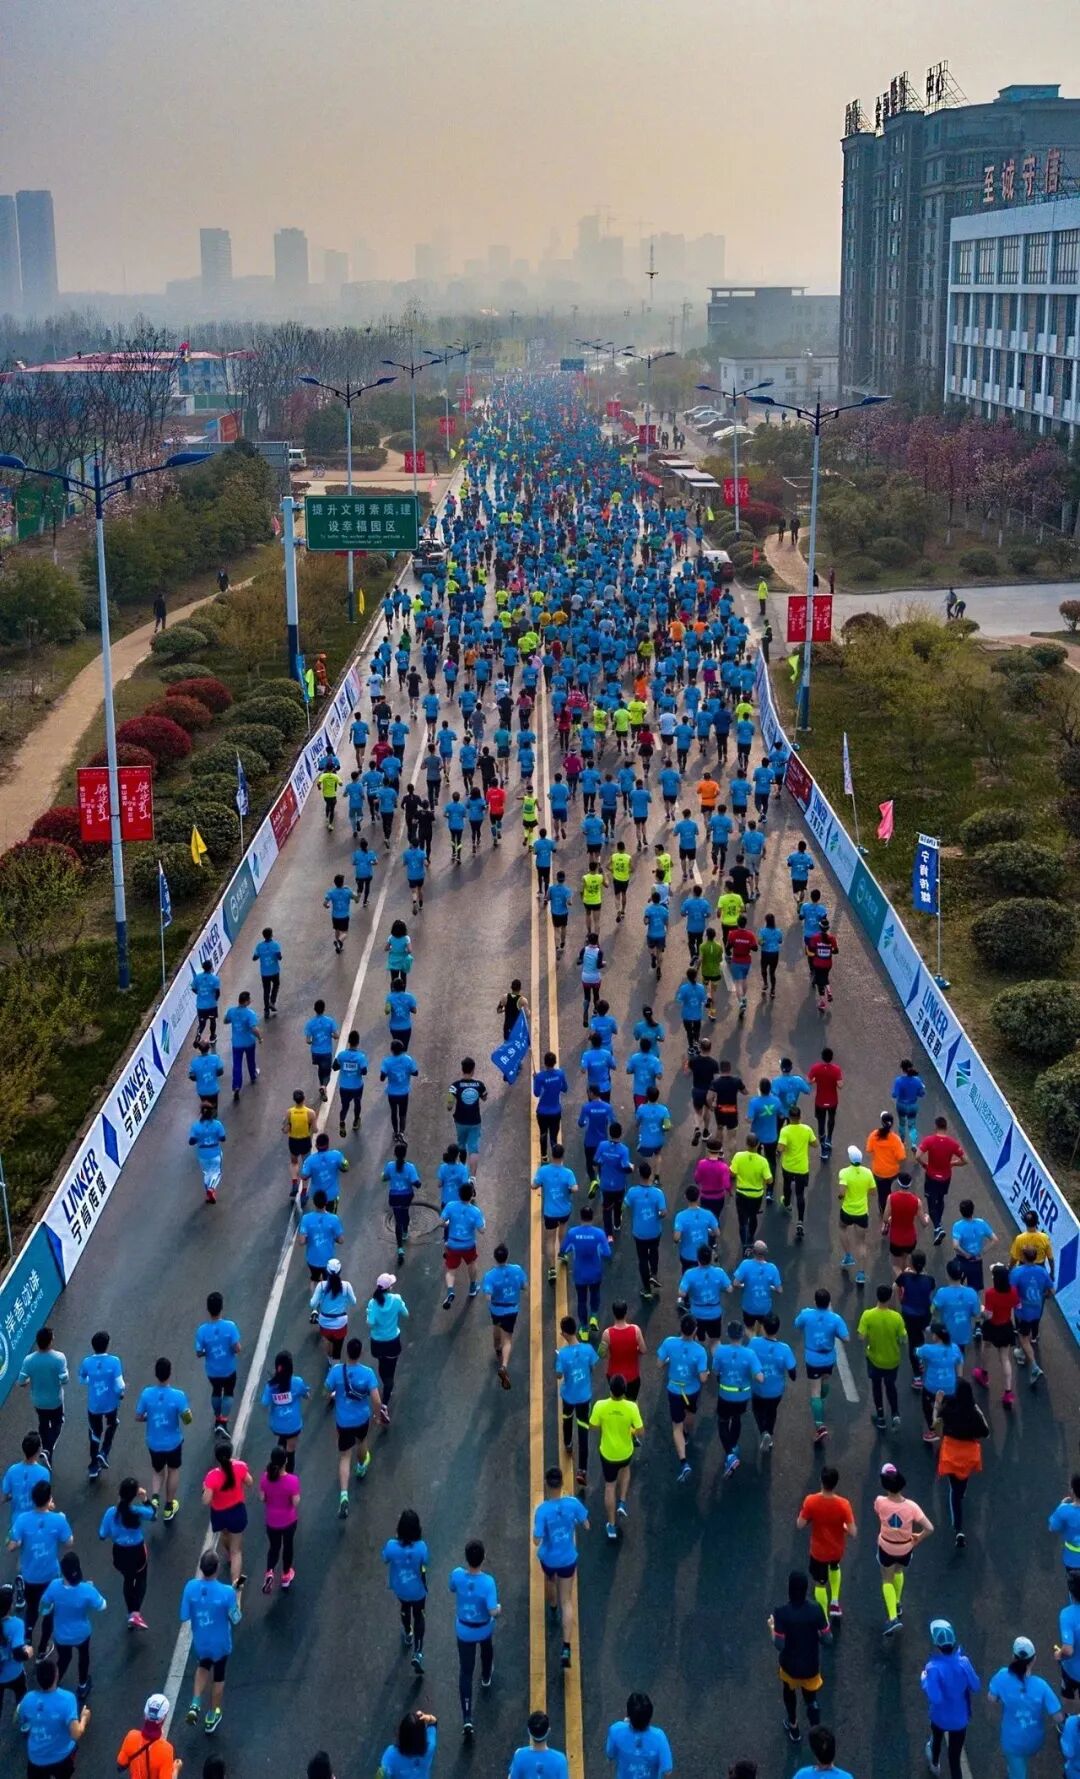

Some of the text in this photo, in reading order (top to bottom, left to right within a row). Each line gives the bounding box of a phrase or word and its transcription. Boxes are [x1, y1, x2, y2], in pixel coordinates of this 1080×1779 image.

[922, 985, 948, 1040] LINKER
[117, 1057, 148, 1119] LINKER
[61, 1148, 99, 1225] LINKER
[1017, 1153, 1058, 1233] LINKER
